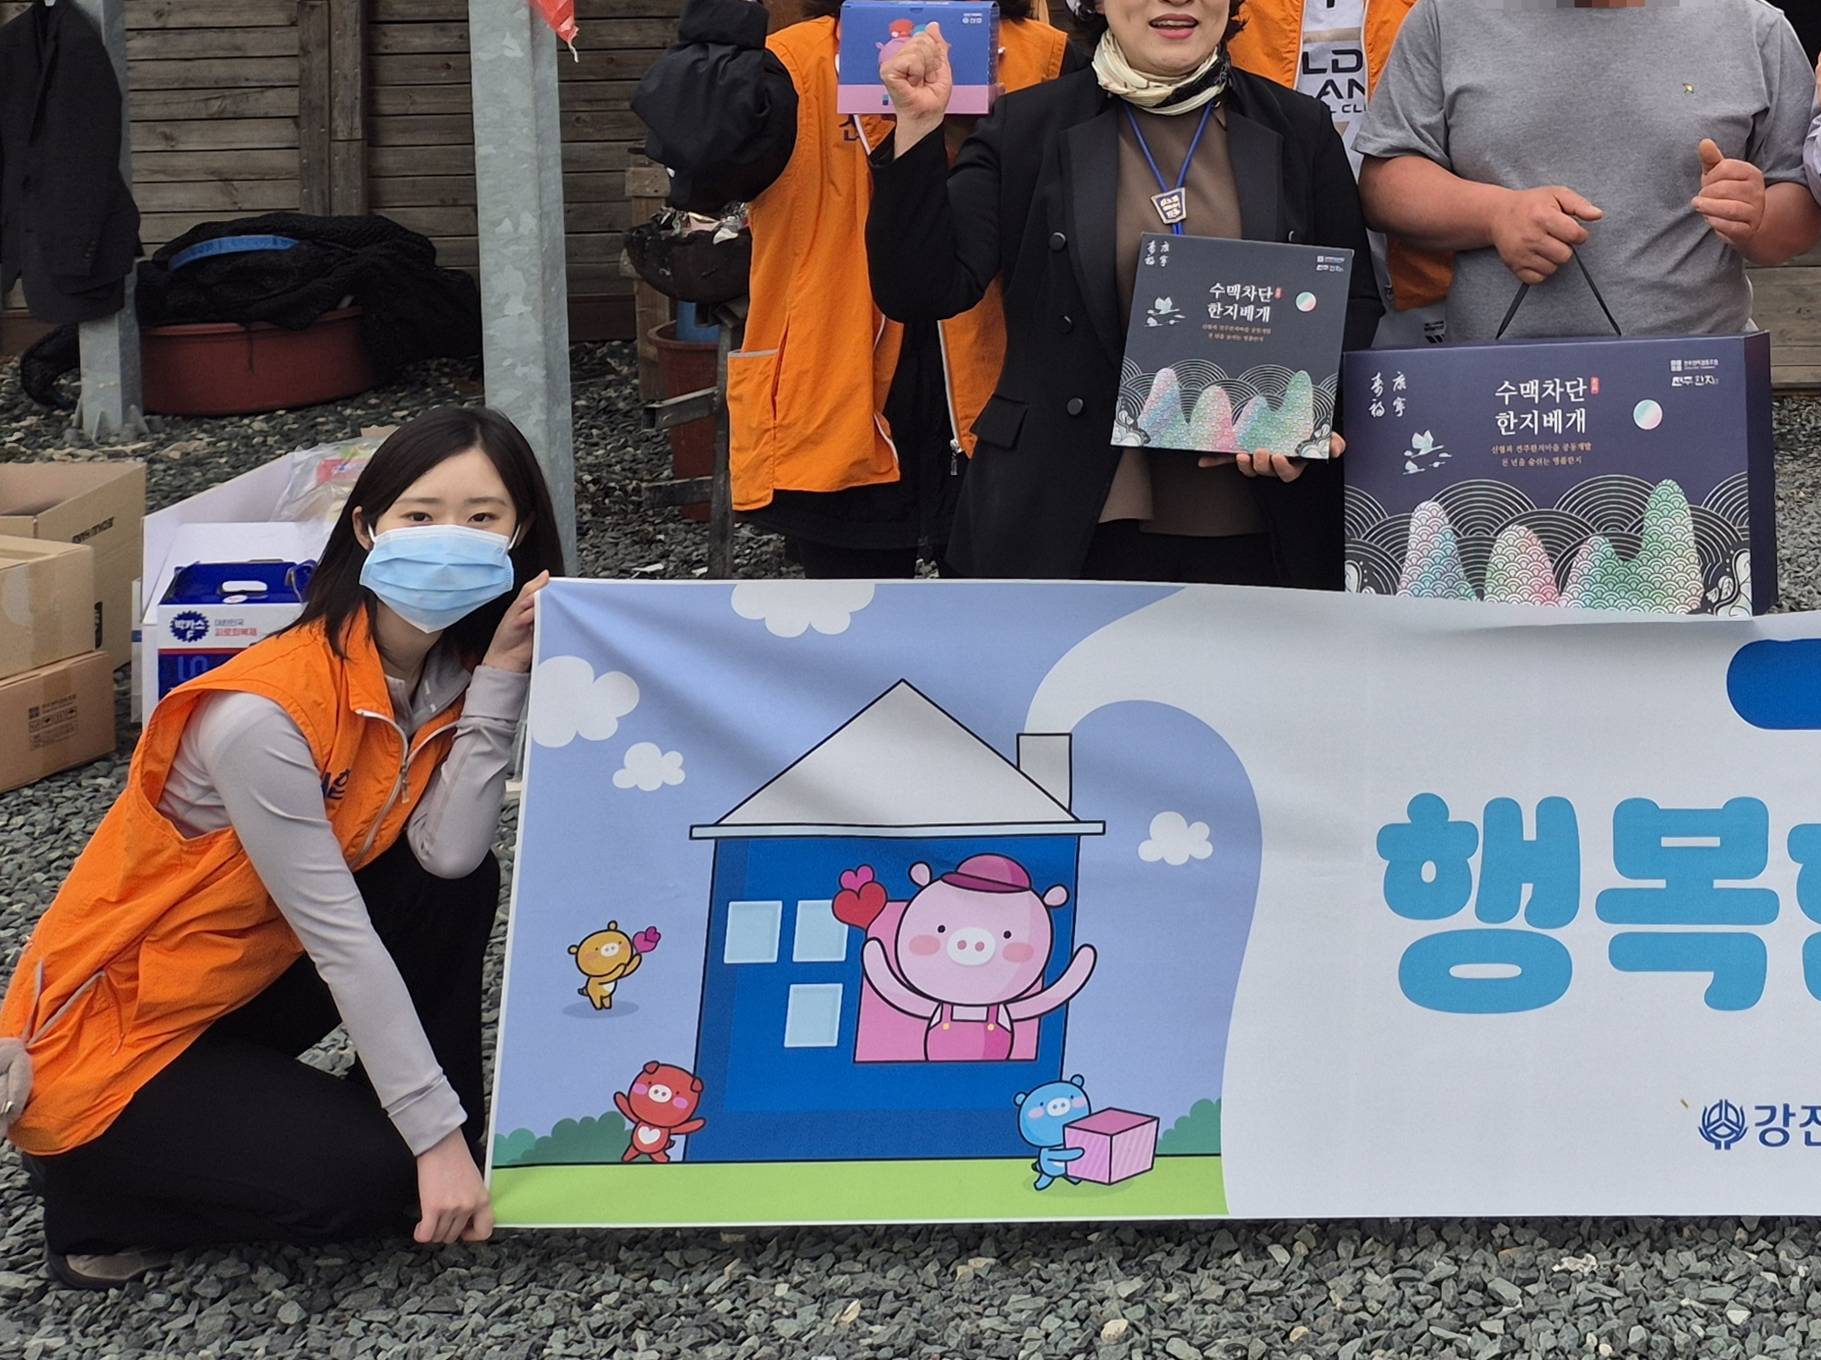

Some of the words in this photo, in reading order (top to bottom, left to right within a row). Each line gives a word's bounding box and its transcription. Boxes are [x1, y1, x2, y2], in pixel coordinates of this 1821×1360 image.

[1209, 282, 1274, 304] 수맥차단
[1207, 302, 1271, 324] 한지베개
[1495, 377, 1588, 406] 수맥차단
[1495, 407, 1587, 436] 한지베개
